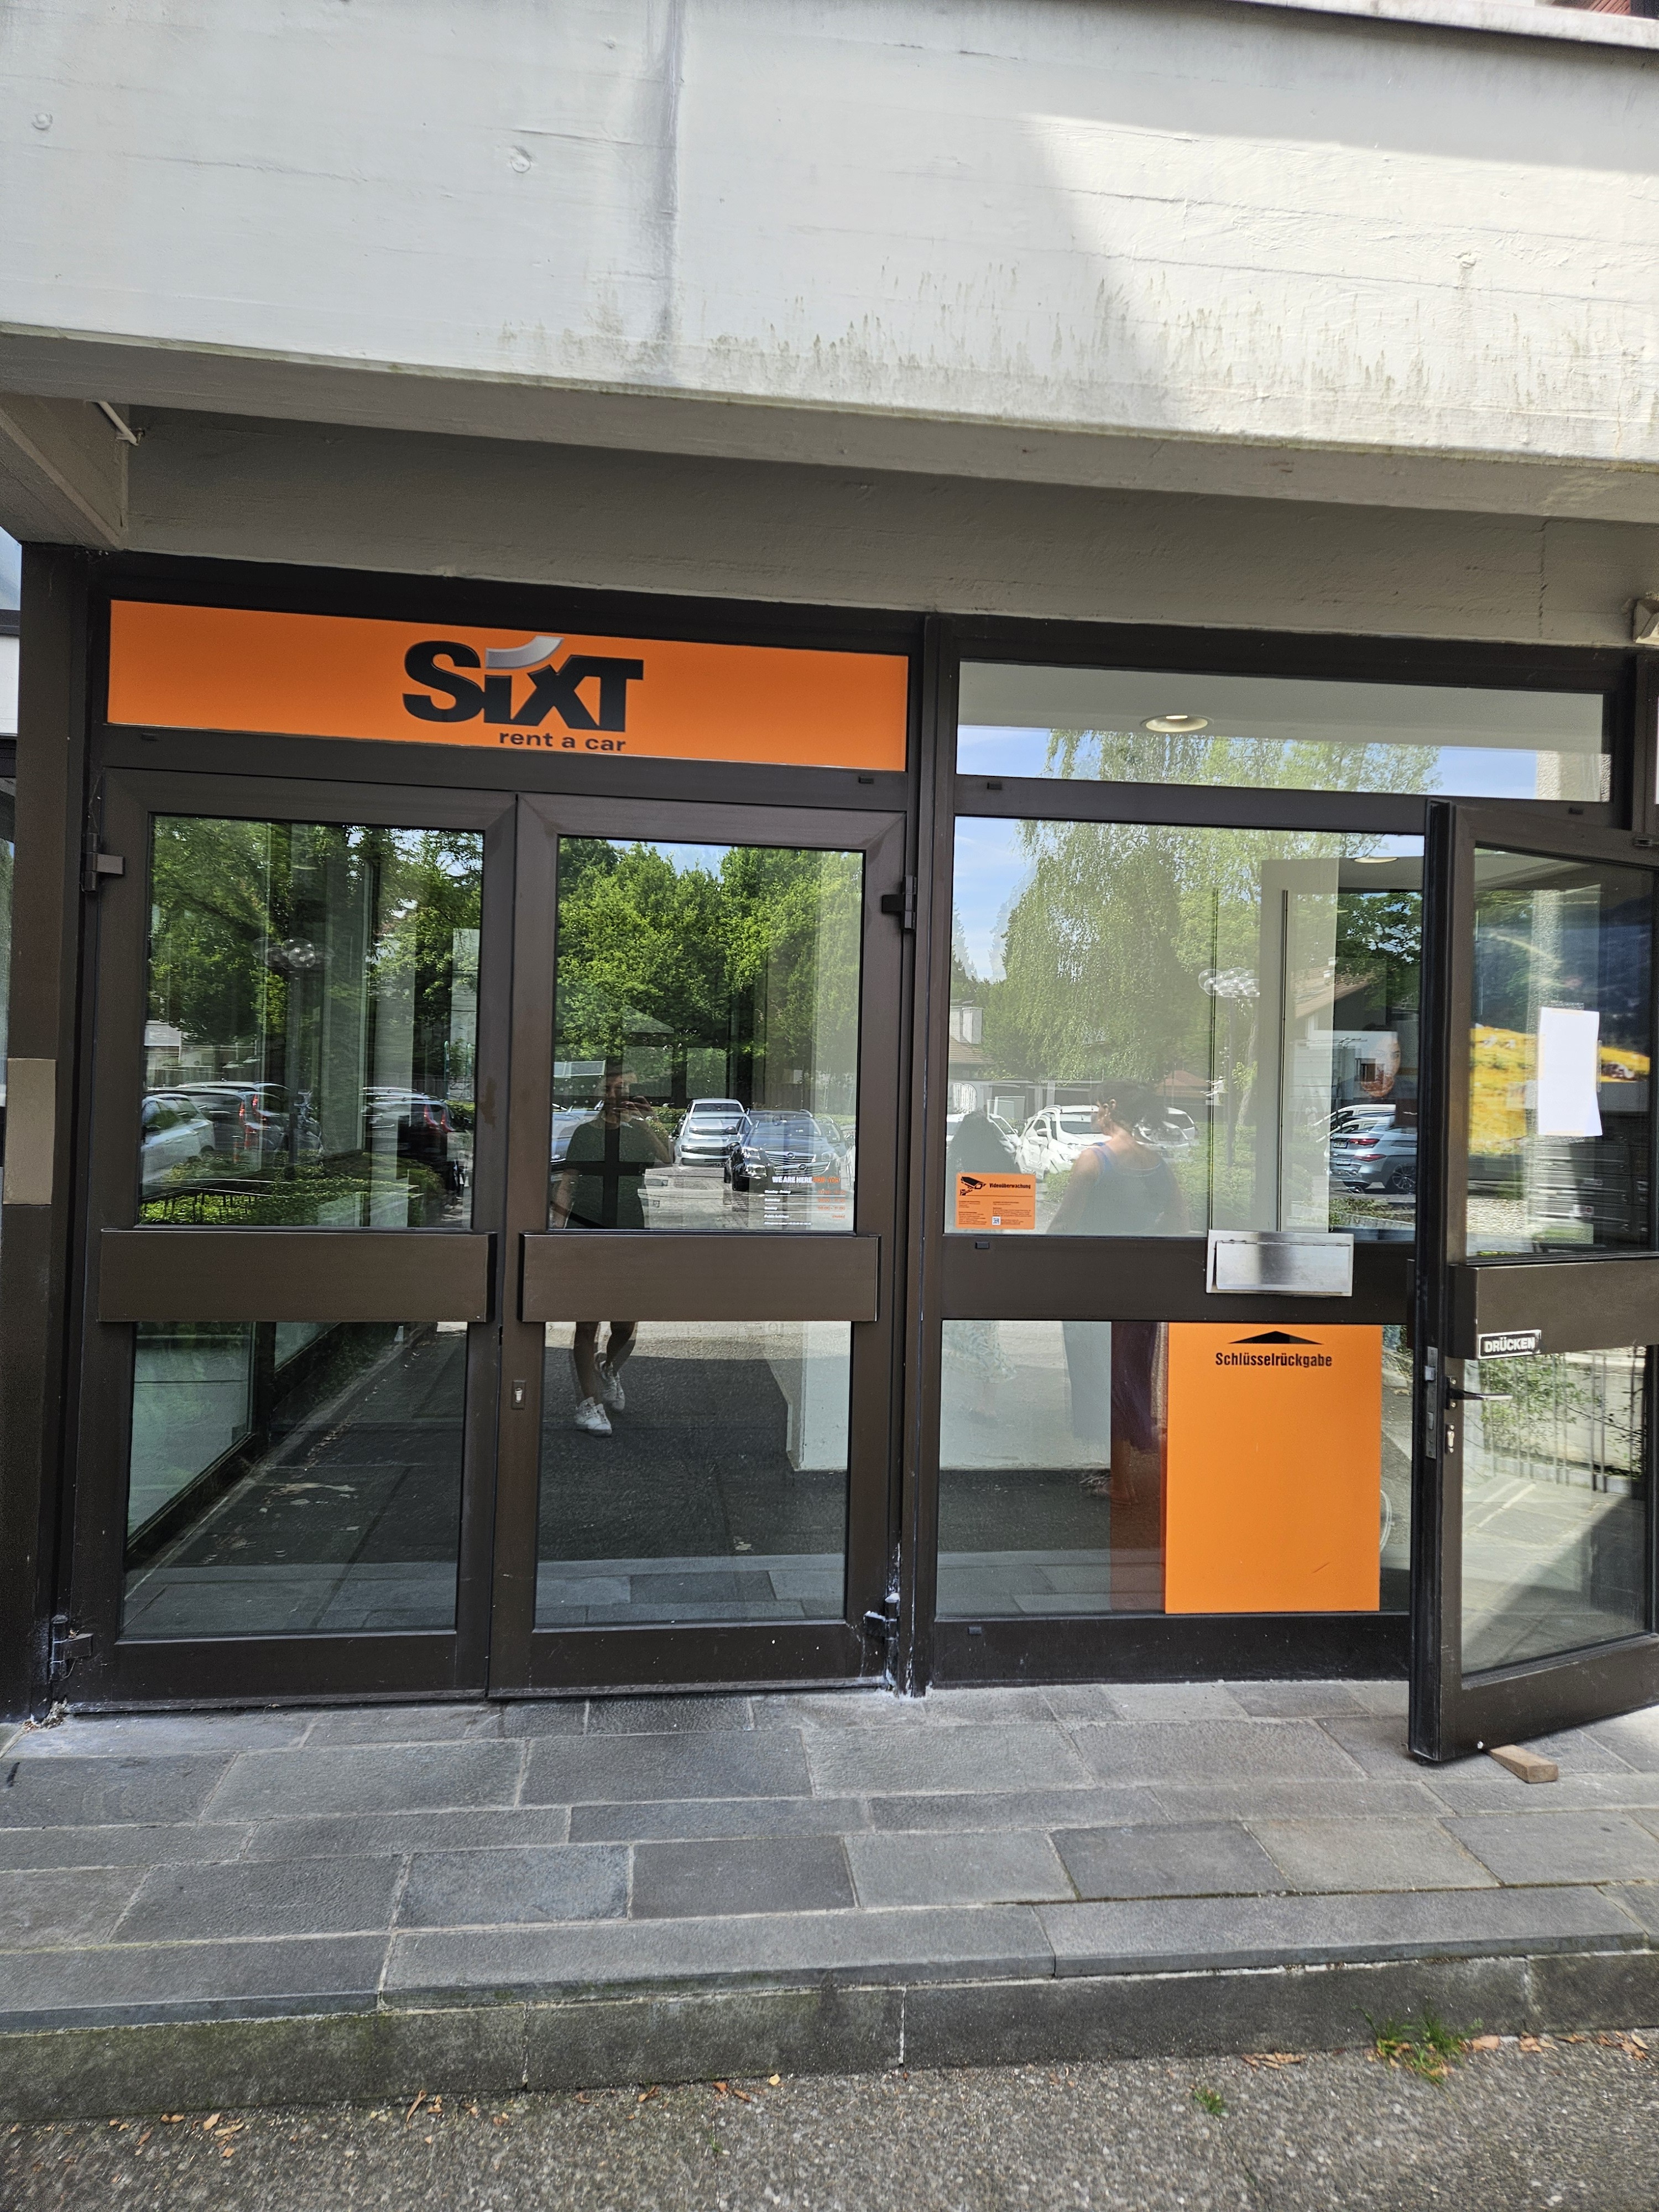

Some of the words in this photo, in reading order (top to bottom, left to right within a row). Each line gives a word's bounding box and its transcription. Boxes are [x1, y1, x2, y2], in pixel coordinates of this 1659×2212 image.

[499, 732, 553, 747] rent
[561, 736, 576, 749] a
[585, 738, 626, 752] car
[1484, 1336, 1535, 1353] DRÜCKEN
[1215, 1352, 1332, 1368] Schlüsselrückgabe
